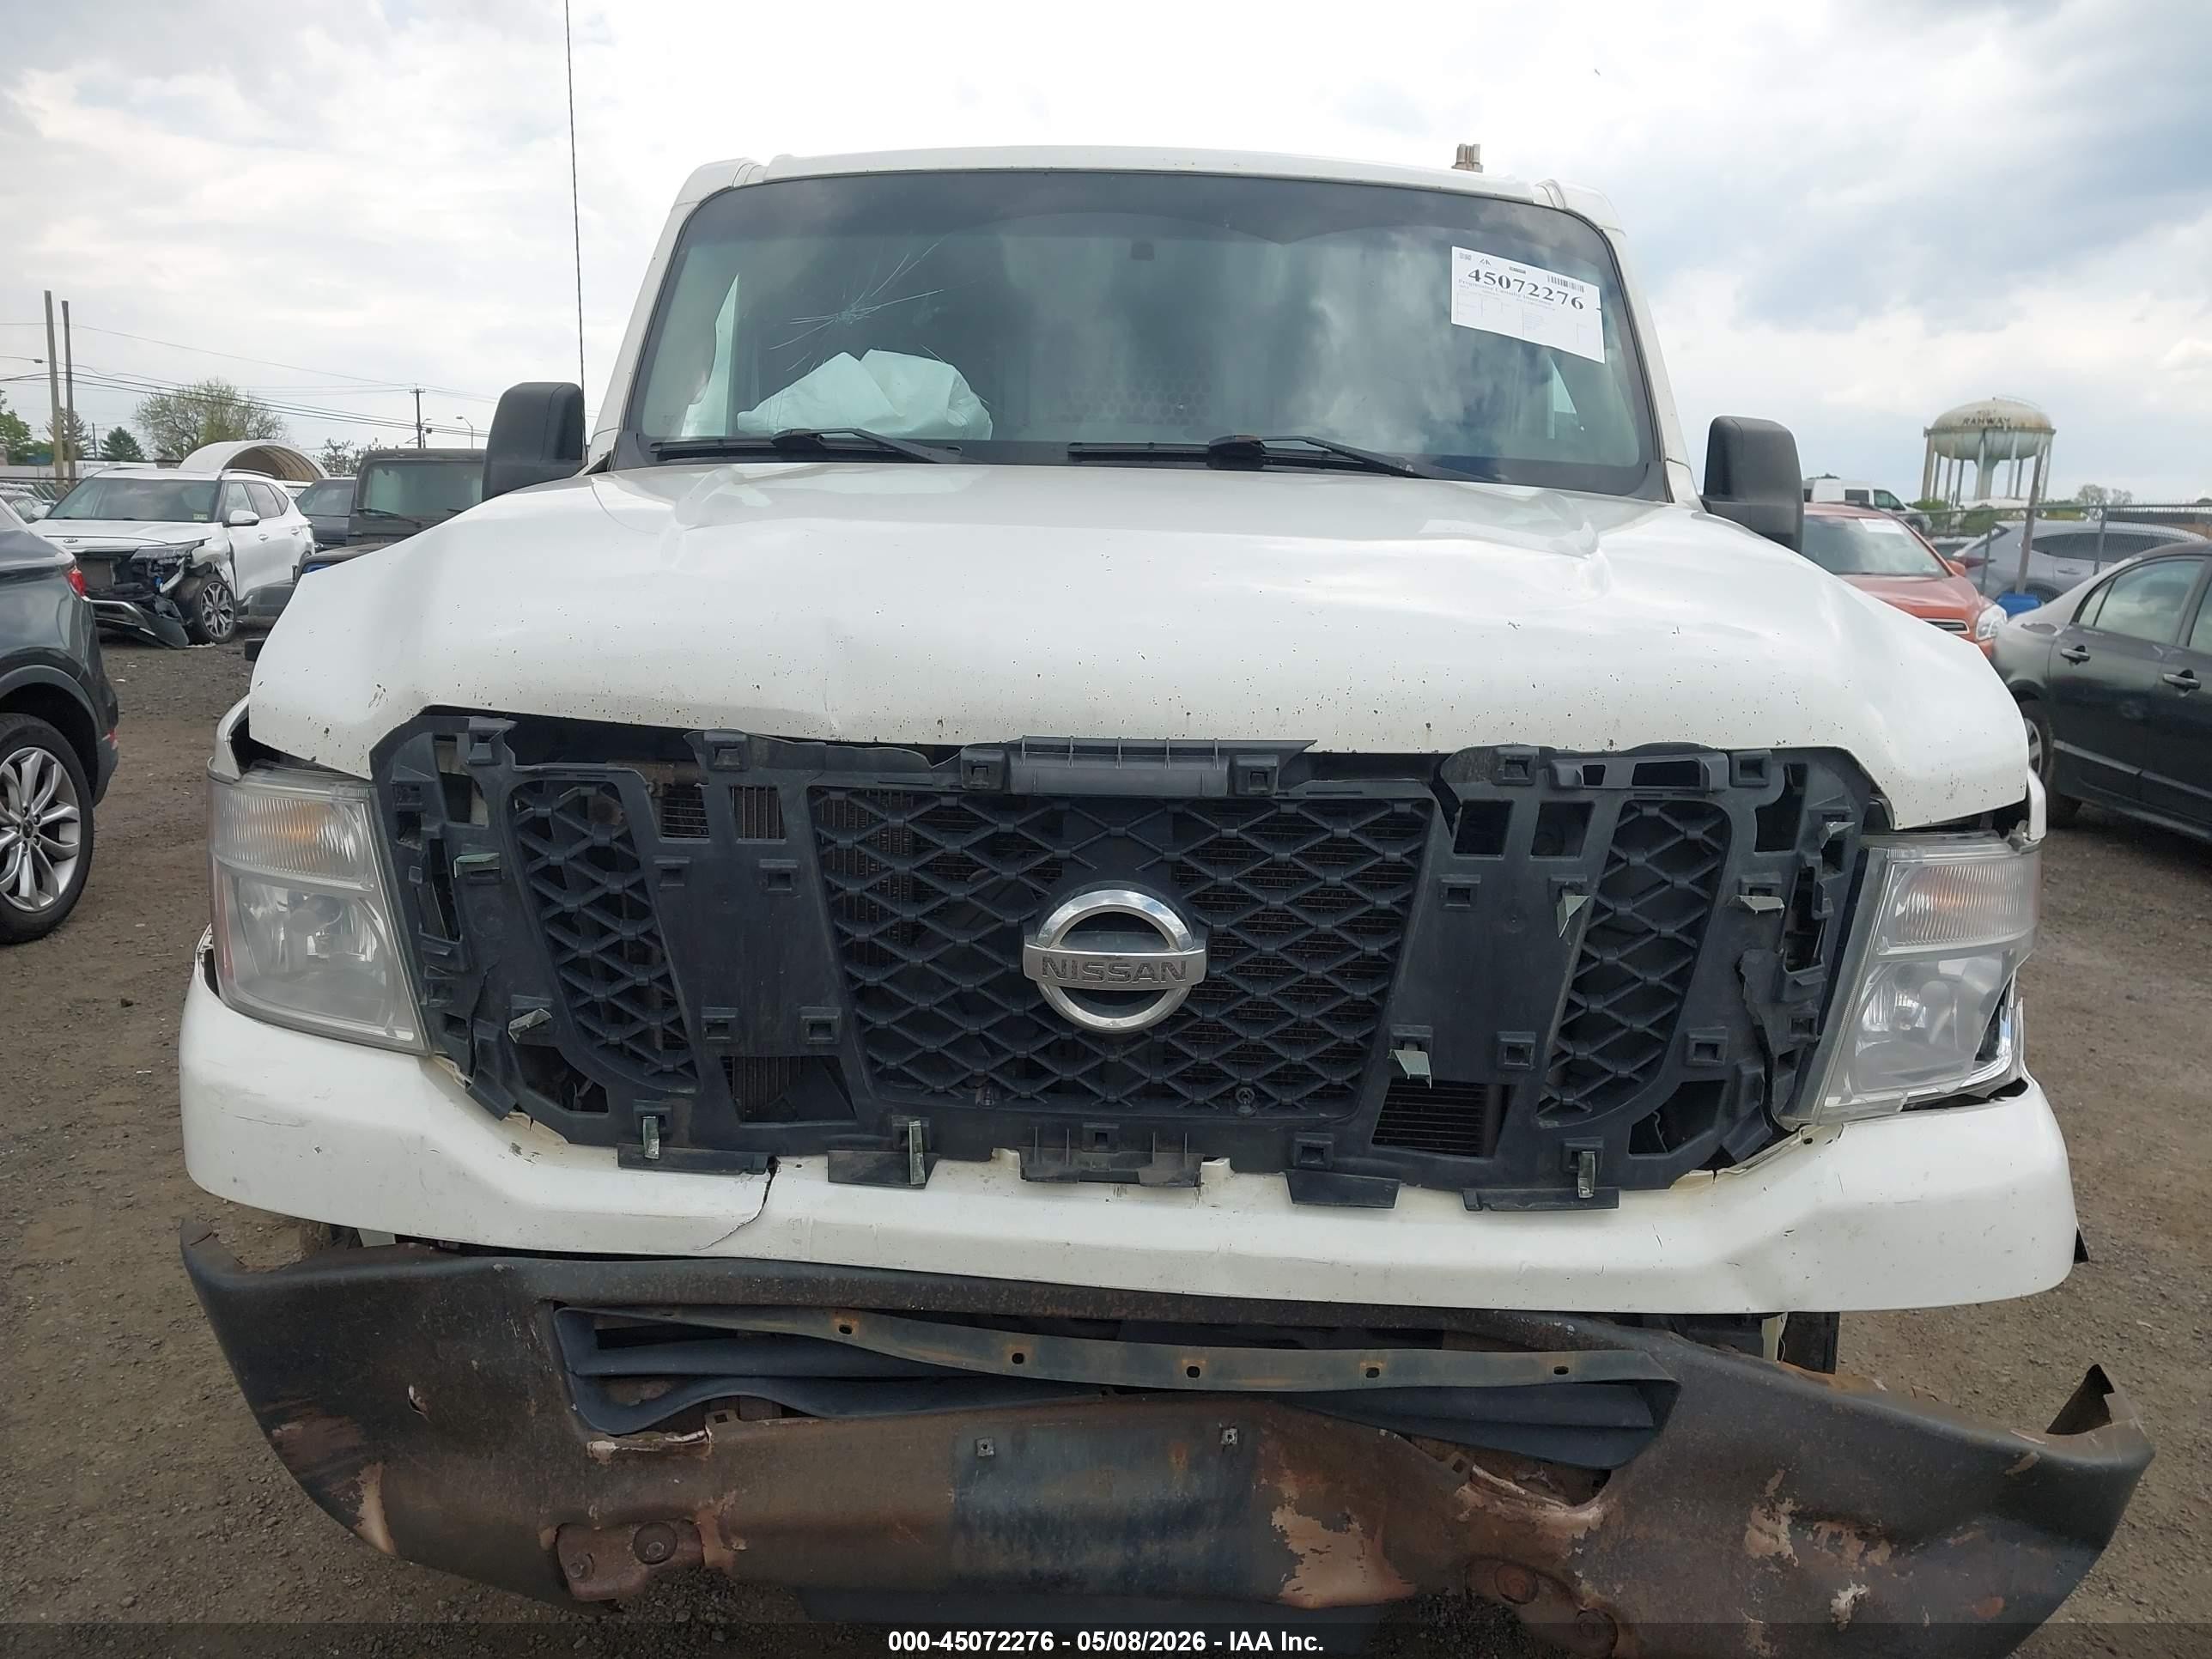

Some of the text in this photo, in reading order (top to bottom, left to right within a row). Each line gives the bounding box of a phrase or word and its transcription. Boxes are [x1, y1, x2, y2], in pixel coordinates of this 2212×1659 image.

[1468, 269, 1584, 310] 45072276
[1963, 417, 2011, 427] RAHWAY
[1042, 955, 1187, 983] NISSAN
